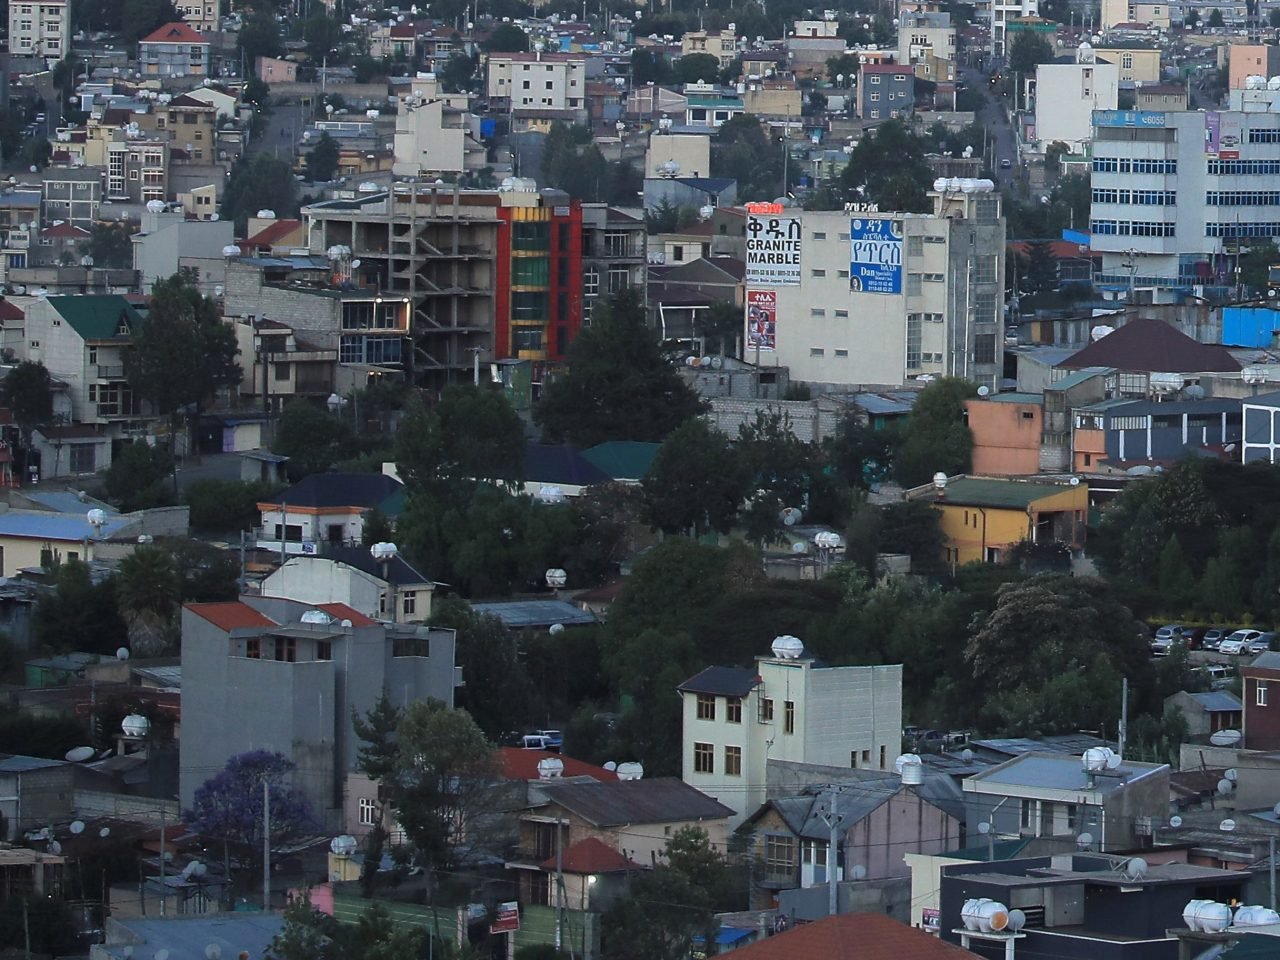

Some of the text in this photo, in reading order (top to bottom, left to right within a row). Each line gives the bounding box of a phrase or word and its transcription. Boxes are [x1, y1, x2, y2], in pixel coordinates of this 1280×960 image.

[748, 216, 801, 239] ቅዱስ
[747, 239, 800, 251] GRANITE
[748, 252, 800, 264] MARBLE
[853, 242, 900, 269] የጥርስ
[861, 267, 875, 276] Dan
